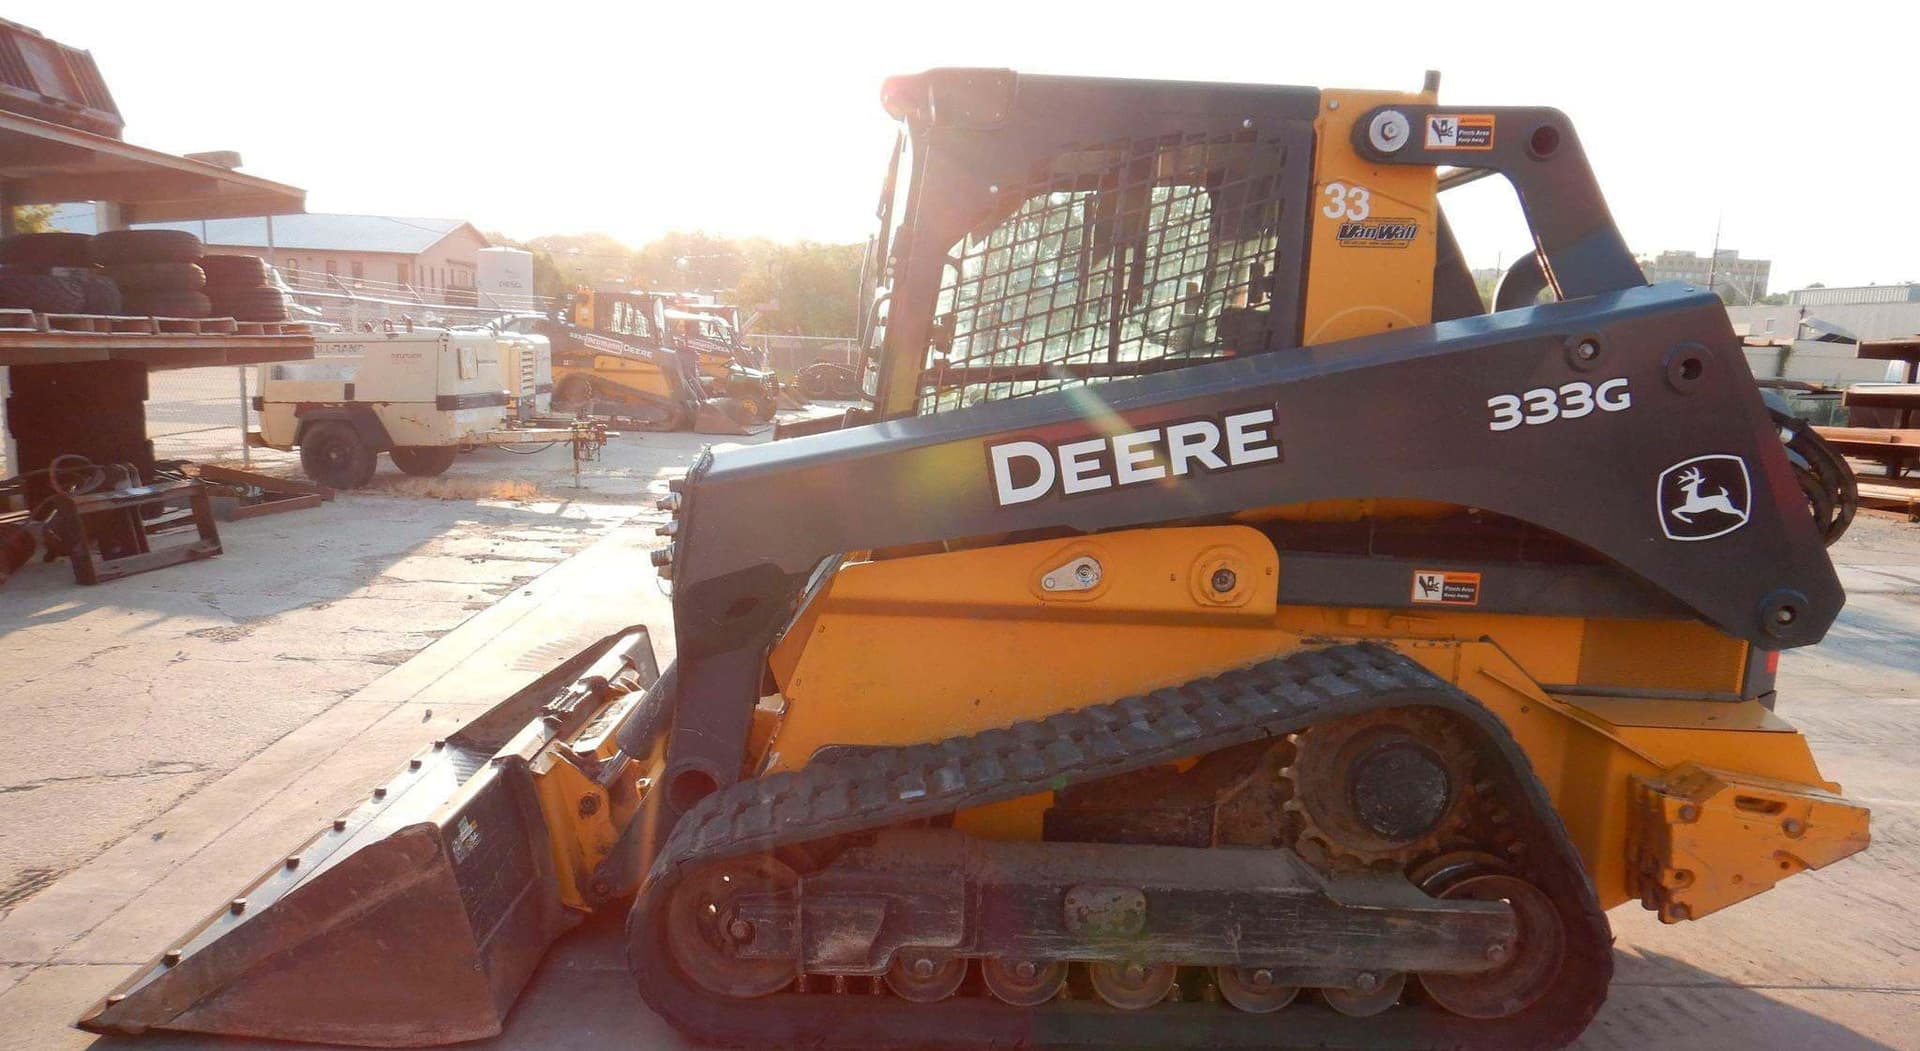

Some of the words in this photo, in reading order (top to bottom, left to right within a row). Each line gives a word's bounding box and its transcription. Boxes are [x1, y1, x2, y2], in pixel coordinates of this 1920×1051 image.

[1323, 183, 1371, 221] 33
[1487, 378, 1632, 432] 333G
[991, 408, 1280, 505] DEERE
